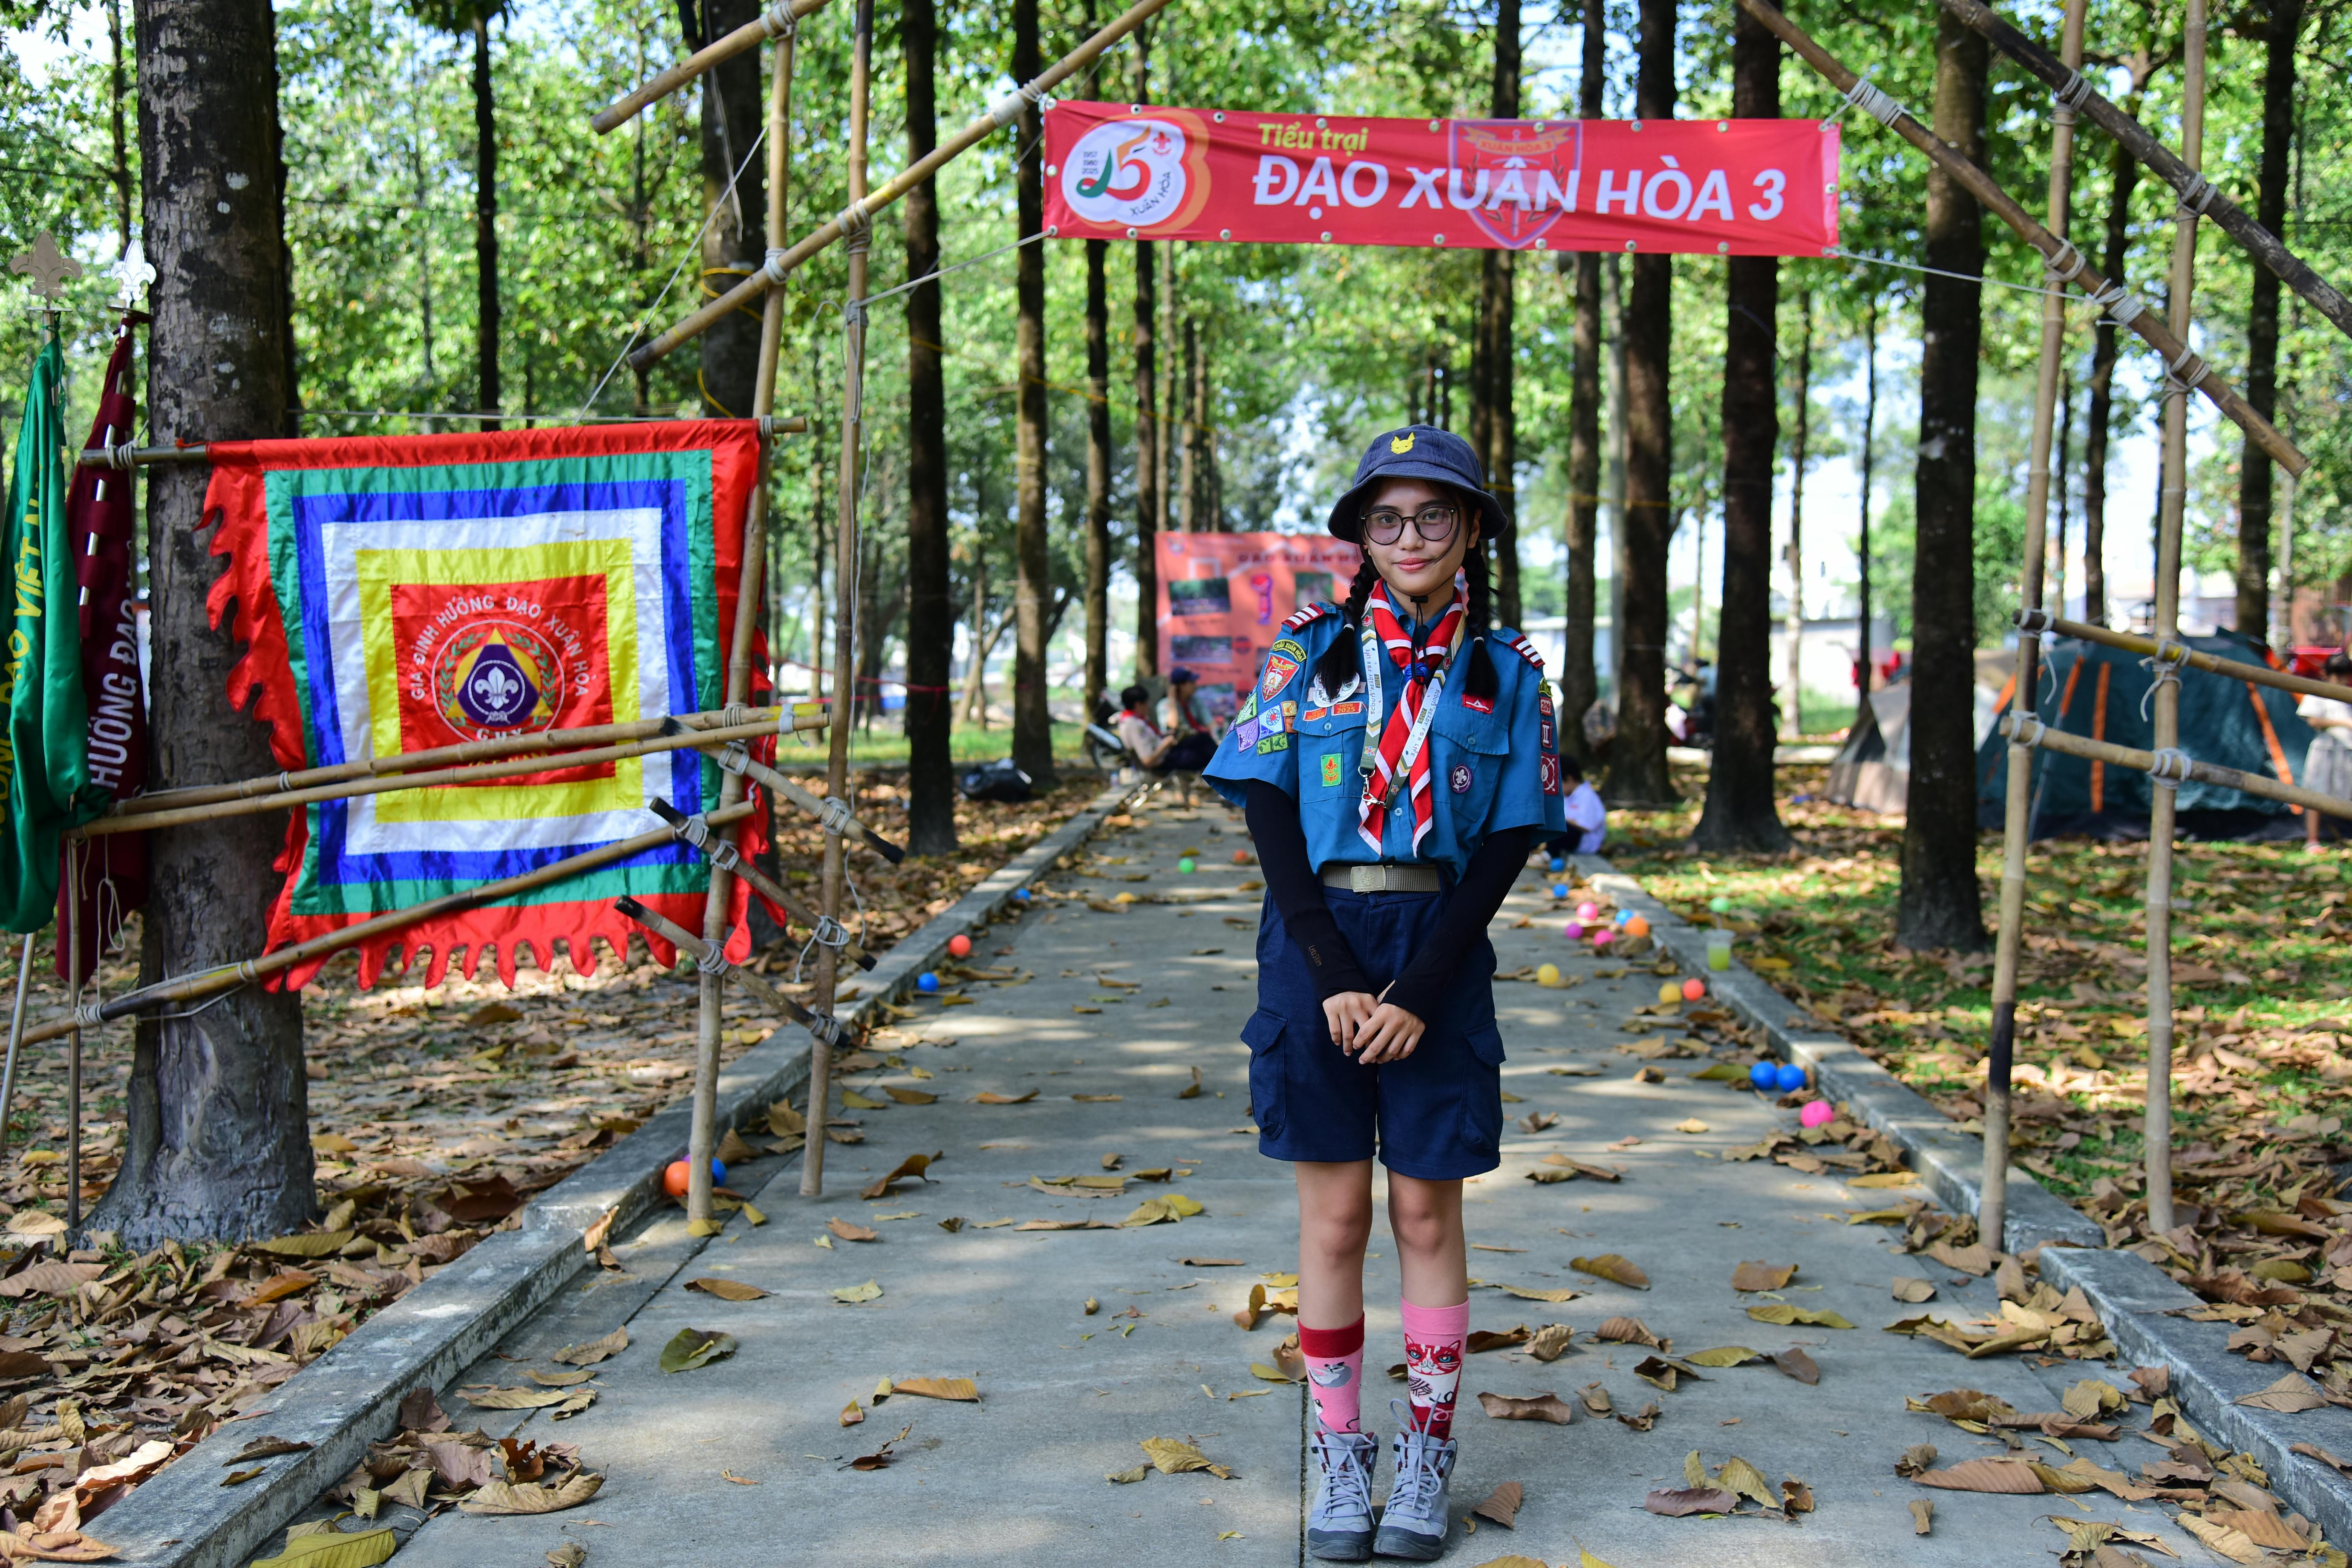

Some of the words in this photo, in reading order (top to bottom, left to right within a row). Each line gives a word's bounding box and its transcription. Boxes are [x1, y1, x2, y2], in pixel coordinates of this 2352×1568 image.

[1258, 121, 1313, 150] Tiểu
[1320, 128, 1369, 157] trại
[1130, 198, 1159, 216] XUÂN
[1159, 172, 1170, 197] HÒA
[1253, 154, 1389, 220] ĐẠO
[1398, 155, 1581, 213] XUÂN
[1596, 156, 1734, 221] HÒA
[1749, 169, 1785, 221] 3
[506, 596, 542, 618] ĐẠO
[410, 624, 439, 666] ĐÌNH
[545, 614, 583, 657] XUÂN
[1285, 643, 1296, 652] XUÂN
[410, 671, 425, 700] GIA
[573, 660, 597, 697] HÒA
[1431, 689, 1440, 706] SCOUTS
[1418, 708, 1427, 723] 2025
[1424, 708, 1434, 726] READY
